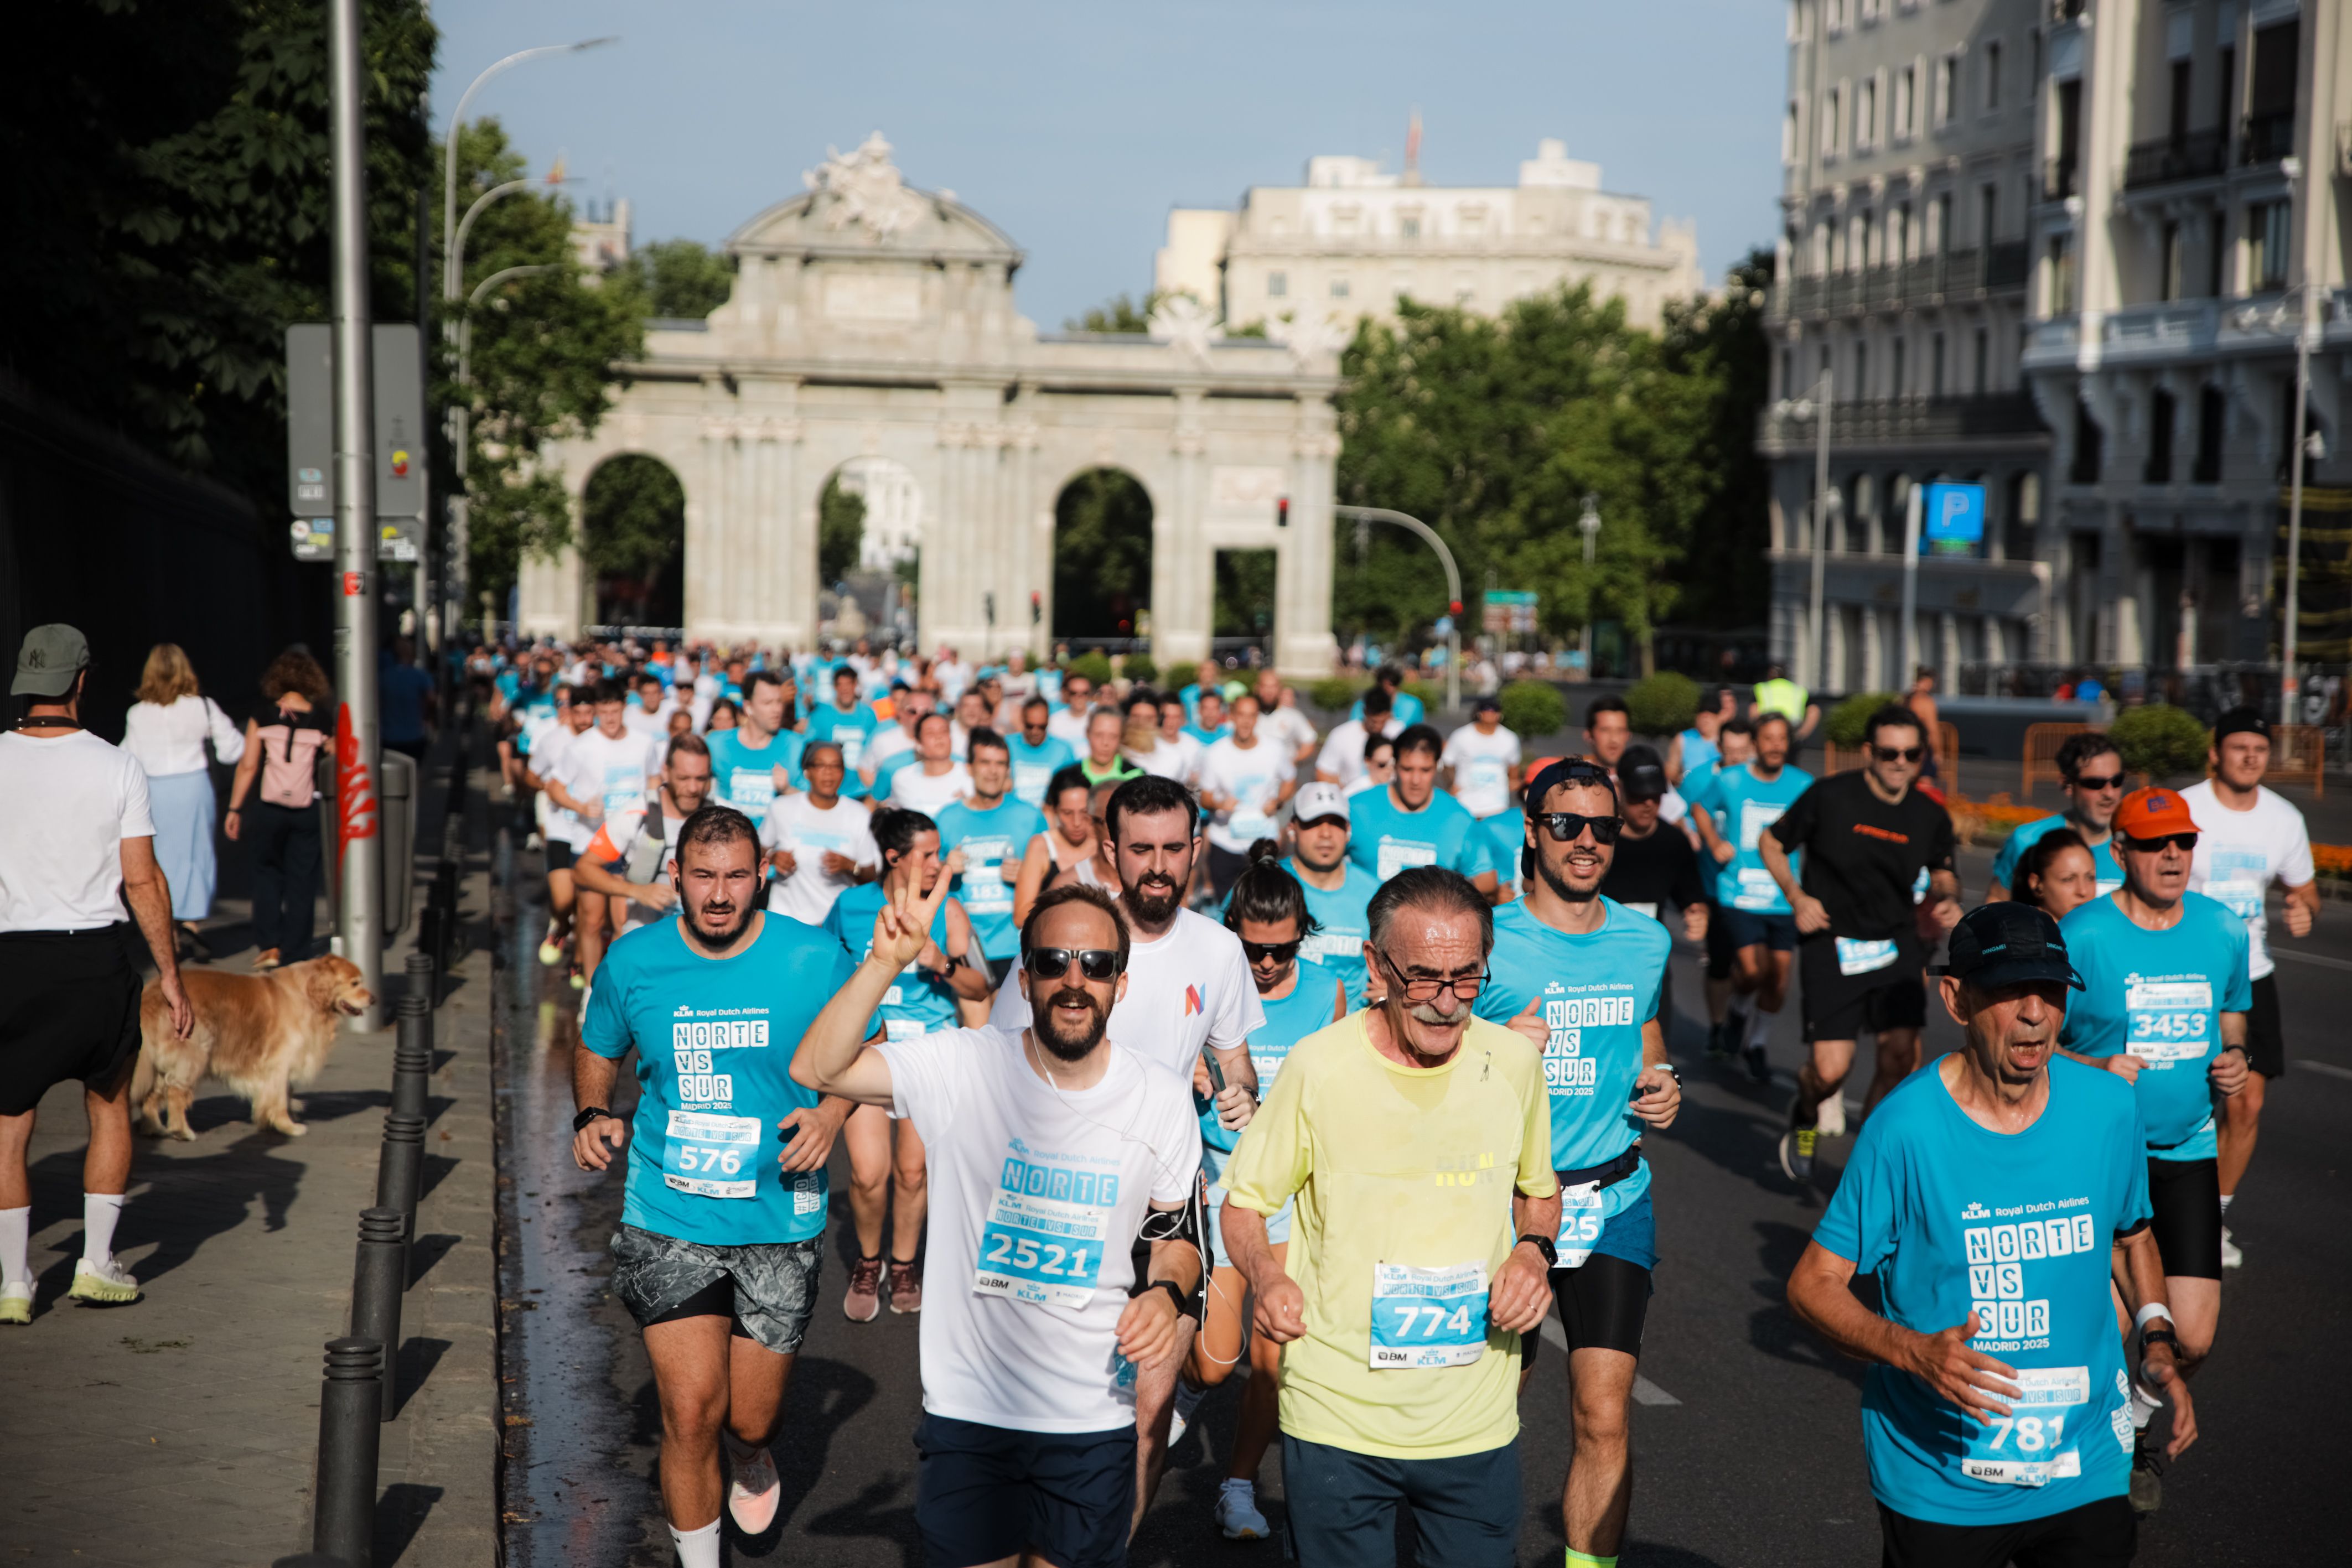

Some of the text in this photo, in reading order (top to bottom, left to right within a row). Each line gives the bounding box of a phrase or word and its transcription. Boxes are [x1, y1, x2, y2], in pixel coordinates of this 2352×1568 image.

[1941, 492, 1969, 527] P
[733, 790, 771, 803] 5476
[971, 885, 1003, 899] 183
[1982, 944, 2006, 955] DINGMEI
[1567, 984, 1587, 994] Royal
[696, 1009, 717, 1017] Royal
[718, 1008, 740, 1016] Dutch
[742, 1007, 769, 1015] Airlines
[1549, 1000, 1631, 1026] NORTE
[675, 1024, 765, 1047] NORTE
[2133, 1013, 2207, 1037] 3453
[1548, 1032, 1577, 1054] VS
[676, 1053, 710, 1071] VS
[1545, 1061, 1592, 1082] SUR
[681, 1077, 729, 1099] SUR
[1548, 1087, 1594, 1096] ADRID 2025
[681, 1102, 733, 1111] MADRID 2025
[674, 1125, 752, 1142] NORTE VS SUR
[678, 1145, 741, 1175] 576
[1008, 1141, 1121, 1166] KLM Royal Dutch Airlines
[1435, 1151, 1494, 1187] RUN
[697, 1186, 719, 1195] KLM
[810, 1174, 820, 1210] NOR
[1003, 1159, 1116, 1205] NORTE
[795, 1180, 808, 1212] #GO
[1961, 1196, 2090, 1219] KLM Royal Dutch Airlines
[998, 1198, 1099, 1223] KLM Royal Dutch Airlines
[996, 1208, 1097, 1238] NORTE VS SUR
[1559, 1215, 1599, 1242] 25
[1968, 1218, 2091, 1261] NORTE
[986, 1233, 1087, 1278] 2521
[1382, 1279, 1479, 1297] NORTE VS SUR
[1411, 1273, 1432, 1283] Royal
[1433, 1274, 1454, 1283] Dutch
[1455, 1270, 1479, 1280] Airlines
[1972, 1267, 2019, 1295] VS
[990, 1279, 1086, 1302] BM KLM MADRID
[1394, 1305, 1472, 1338] 774
[1977, 1305, 2045, 1333] SUR
[1972, 1337, 2050, 1352] MADRID 2025
[1389, 1353, 1408, 1362] BM
[1417, 1356, 1447, 1365] KLM
[2025, 1378, 2049, 1387] Dutch
[2028, 1390, 2046, 1404] VS
[2055, 1388, 2081, 1402] SUR
[1989, 1415, 2064, 1452] 781
[1984, 1468, 2048, 1483] BM KLM
